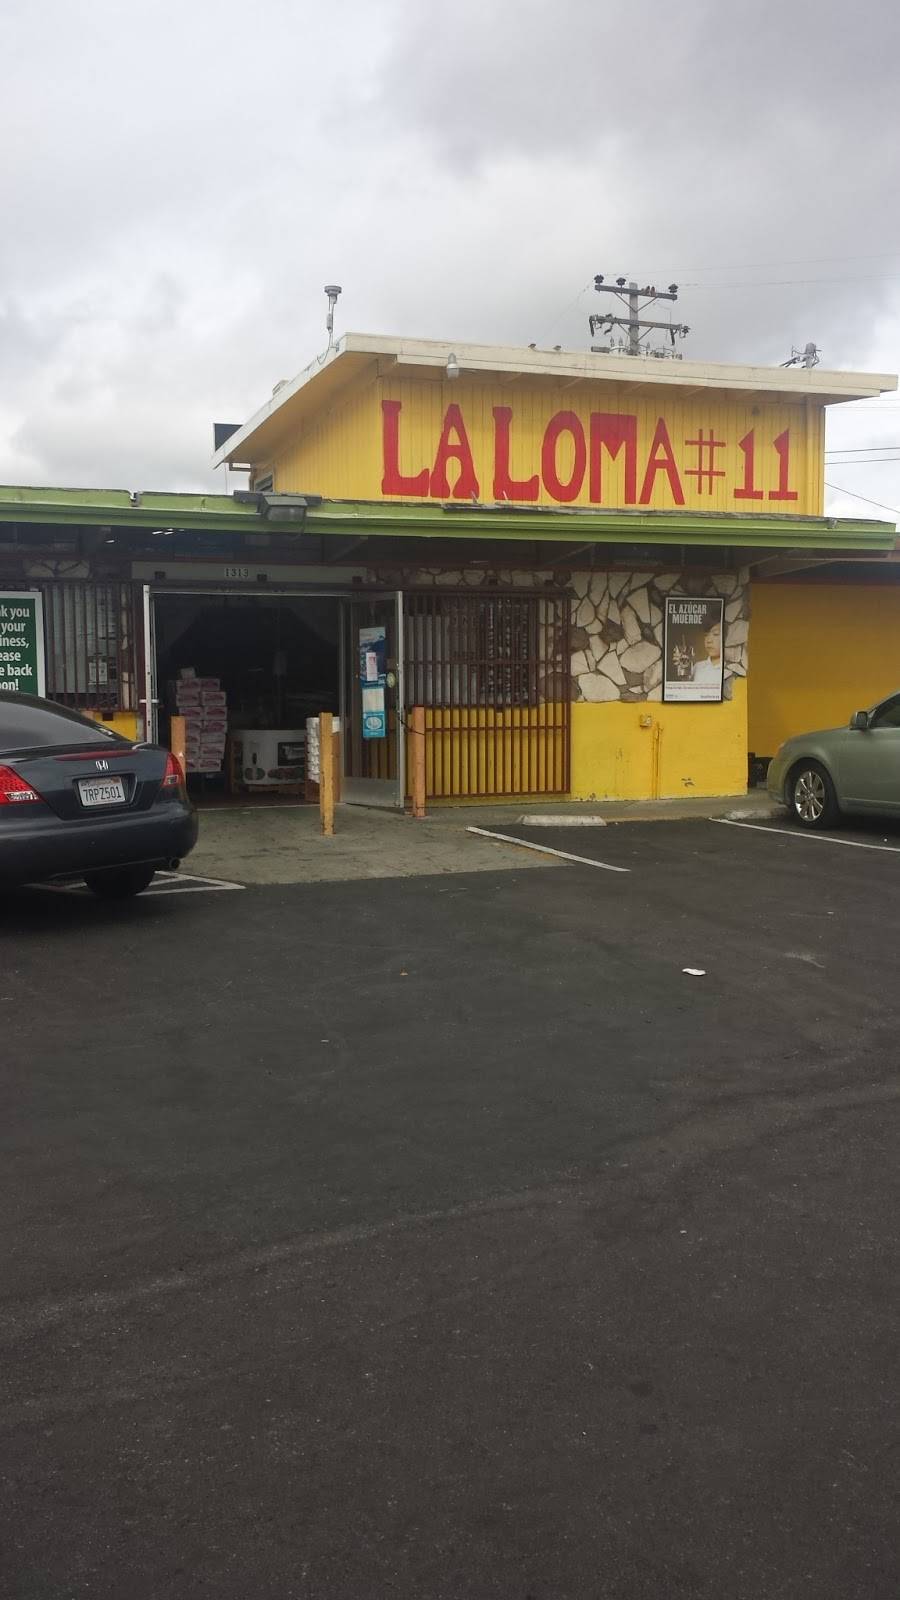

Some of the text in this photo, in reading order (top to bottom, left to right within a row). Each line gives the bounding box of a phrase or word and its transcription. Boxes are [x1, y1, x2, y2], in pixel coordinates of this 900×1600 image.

[381, 399, 479, 498] LA
[492, 405, 685, 505] LOMA
[226, 568, 249, 577] 1313
[10, 607, 30, 620] you
[669, 604, 676, 614] EL
[672, 614, 703, 625] MUERDE
[1, 622, 26, 635] your
[7, 663, 33, 676] back
[82, 785, 122, 802] 7RPZ501
